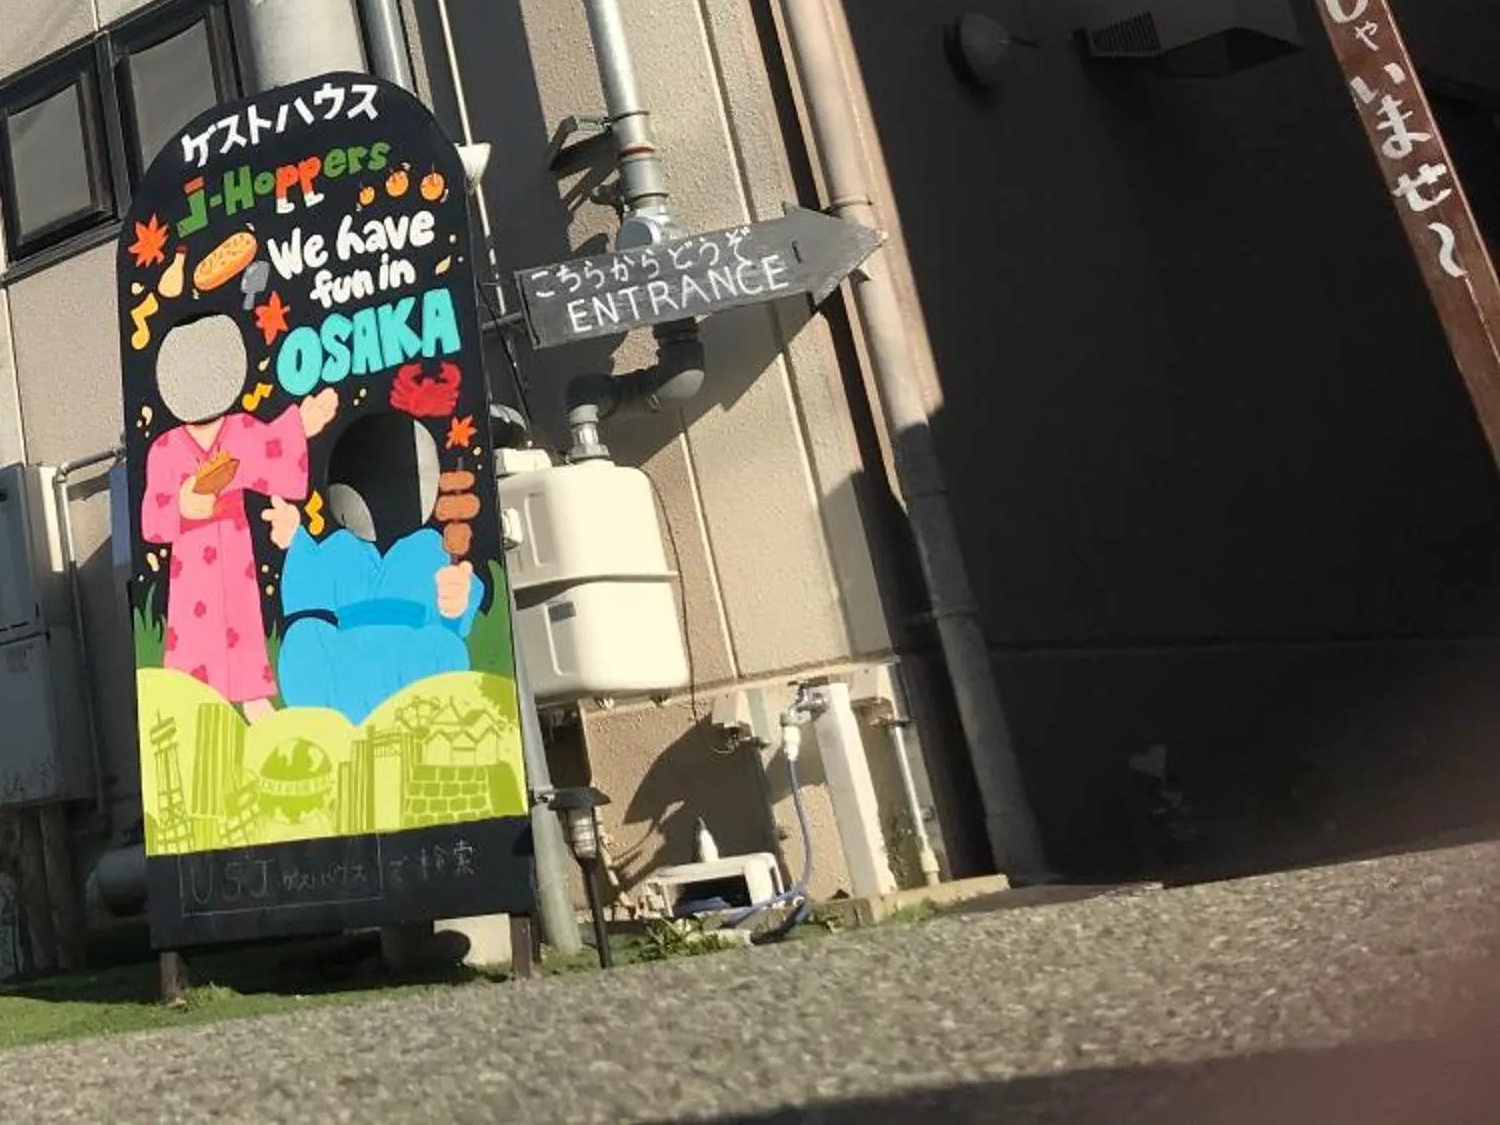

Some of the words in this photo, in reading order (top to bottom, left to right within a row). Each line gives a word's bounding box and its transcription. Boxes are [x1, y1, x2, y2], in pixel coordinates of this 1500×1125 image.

[181, 83, 379, 167] ゲストハウス
[267, 229, 330, 280] We
[336, 210, 435, 260] have
[309, 270, 375, 308] fun
[379, 252, 416, 287] in
[532, 227, 752, 298] こちらからどうぞ
[567, 255, 789, 333] ENTRANCE
[277, 288, 461, 395] OSAKA
